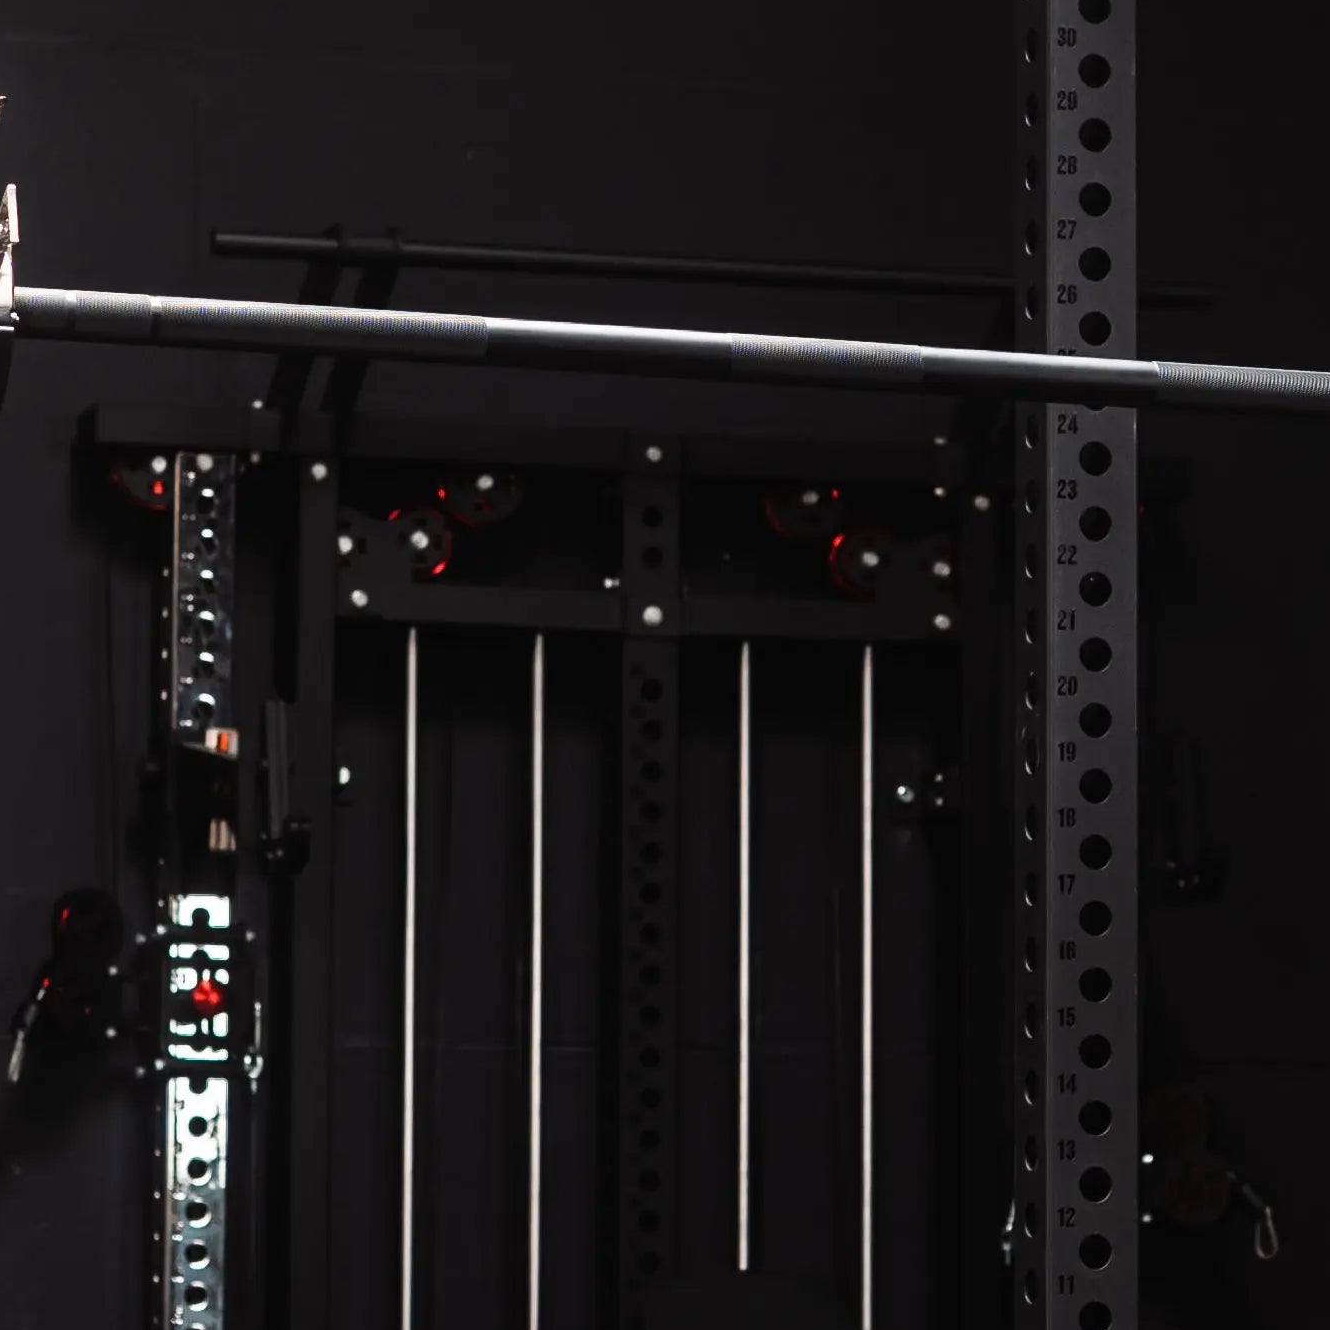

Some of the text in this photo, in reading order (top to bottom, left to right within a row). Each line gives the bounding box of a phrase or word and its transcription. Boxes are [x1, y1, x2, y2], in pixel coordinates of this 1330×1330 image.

[1057, 27, 1076, 47] 30
[1057, 91, 1077, 110] 29
[1057, 156, 1077, 174] 28
[1057, 220, 1077, 239] 27
[1057, 284, 1077, 304] 26
[1057, 415, 1078, 434] 24
[1057, 480, 1077, 499] 23
[1057, 545, 1077, 565] 22
[1057, 610, 1075, 630] 21
[1057, 676, 1077, 696] 20
[1058, 742, 1076, 761] 19
[1058, 874, 1076, 894] 17
[1058, 940, 1076, 960] 16
[1058, 1007, 1076, 1026] 15
[1058, 1074, 1076, 1093] 14
[1058, 1140, 1076, 1159] 13
[1058, 1207, 1076, 1227] 12
[1058, 1275, 1075, 1294] 11
